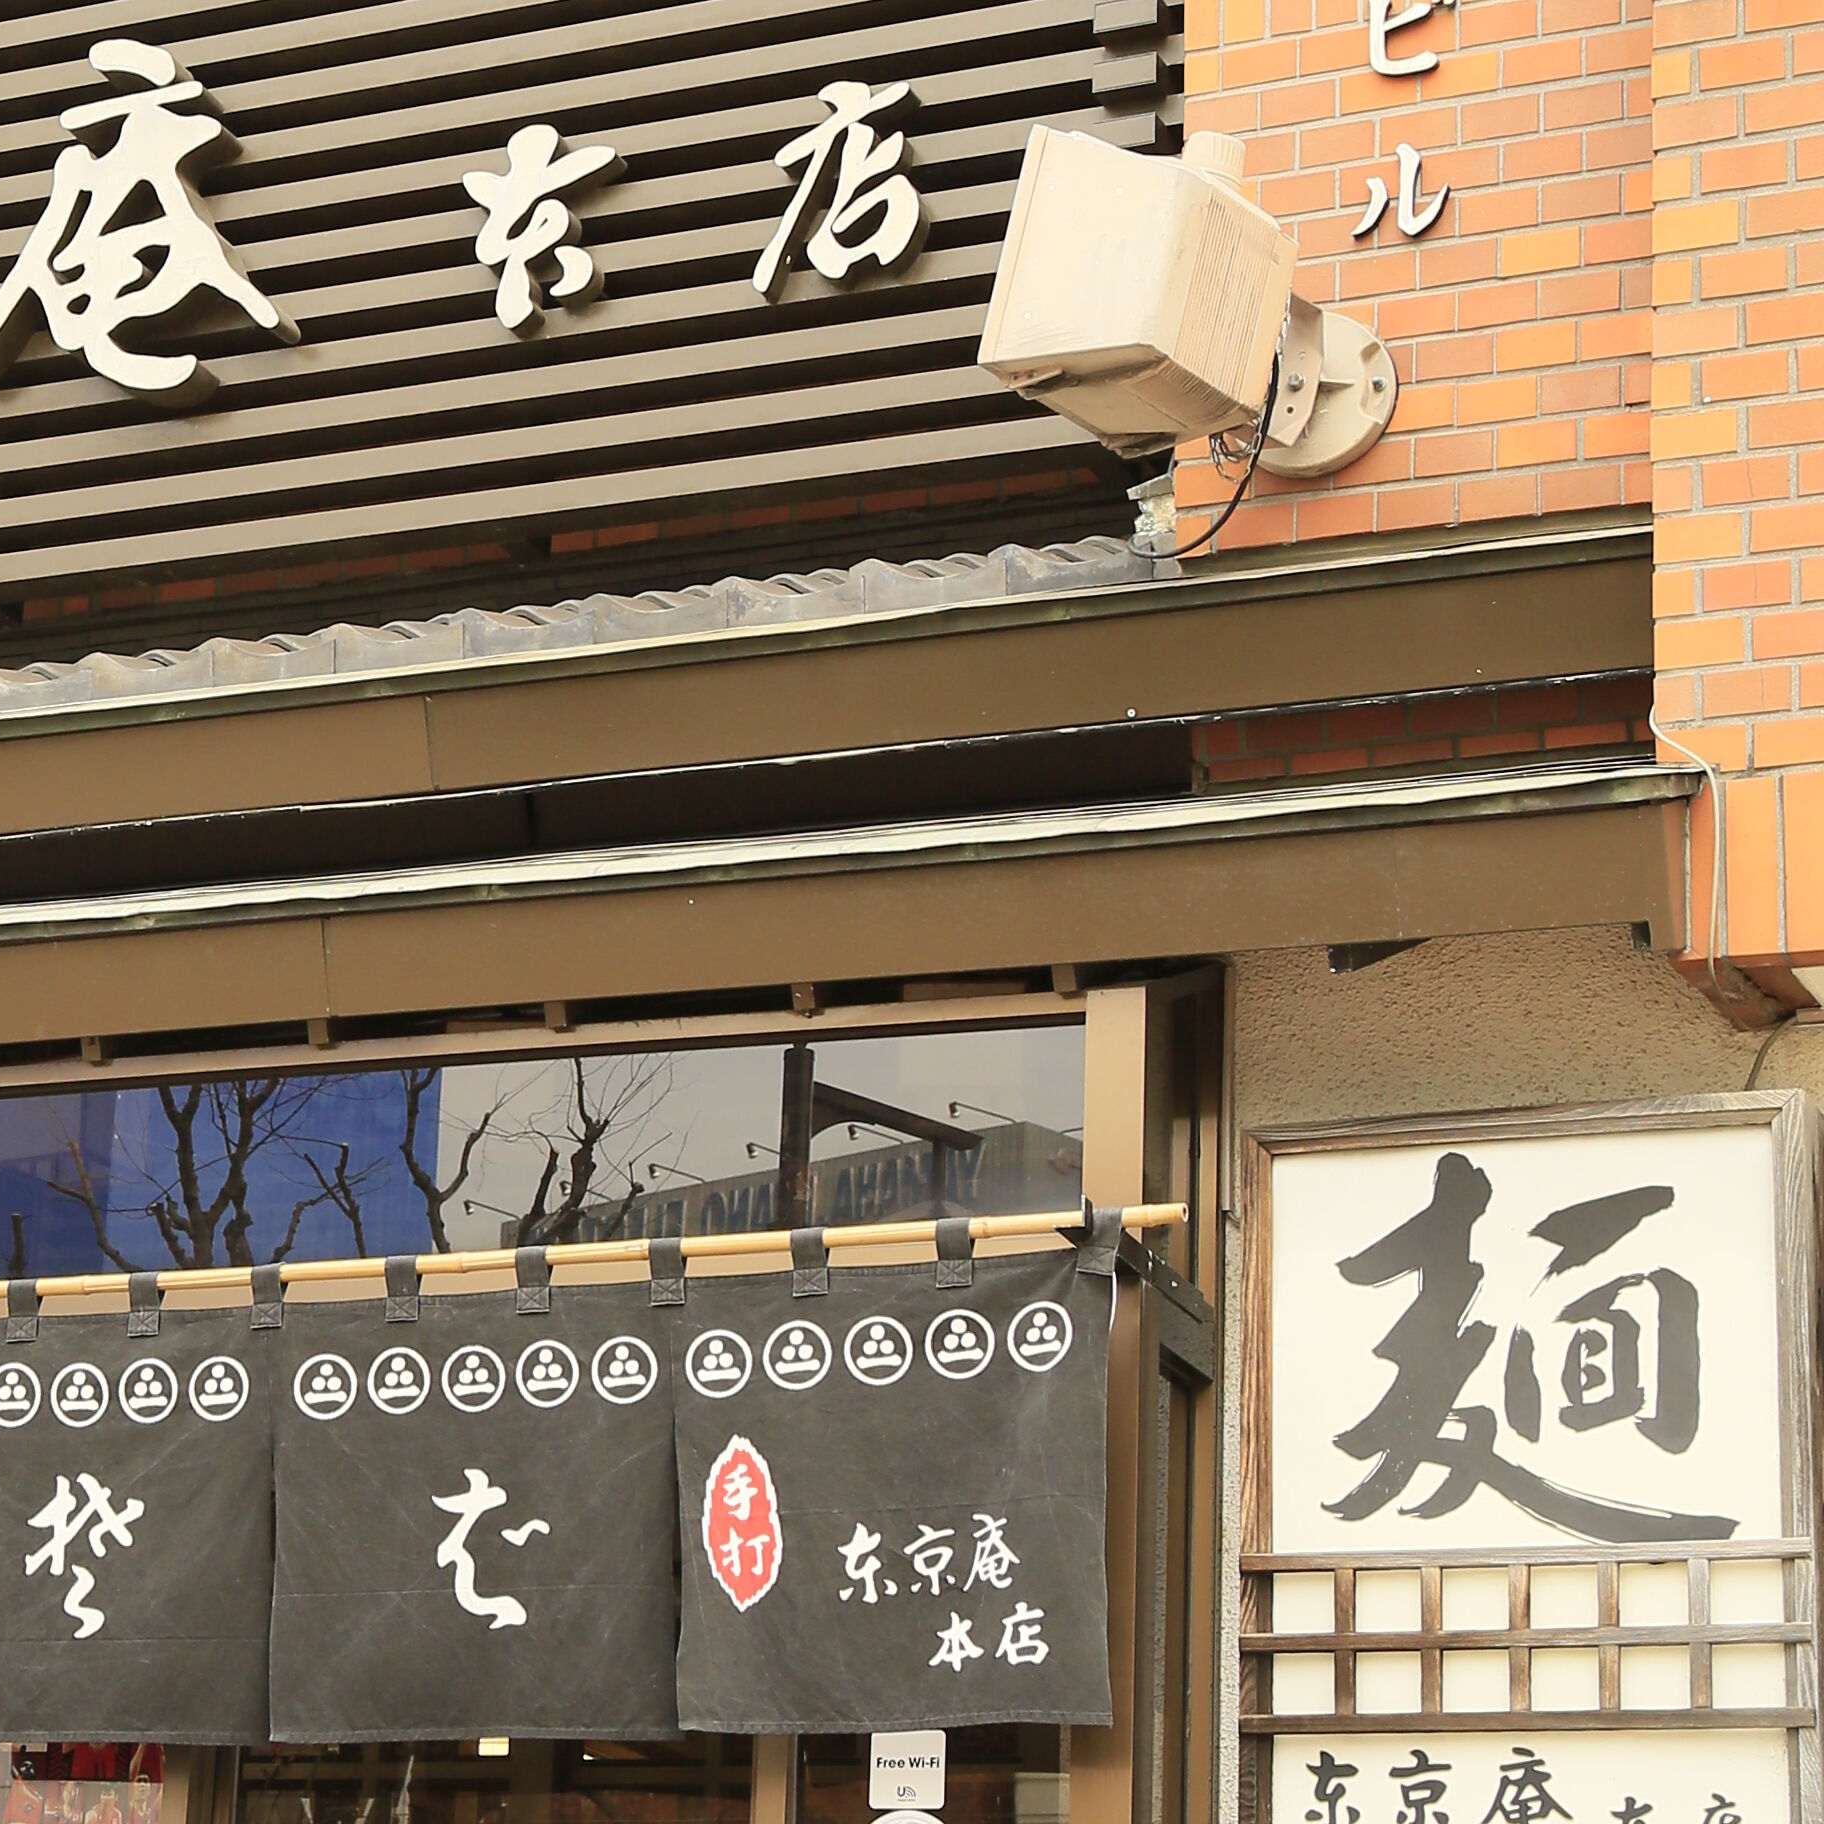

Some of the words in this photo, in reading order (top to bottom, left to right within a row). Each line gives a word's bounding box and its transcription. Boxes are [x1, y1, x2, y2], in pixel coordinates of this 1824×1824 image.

[1321, 1152, 1739, 1544] 麺
[719, 1463, 771, 1577] 手打
[928, 1602, 1050, 1671] 本店
[876, 1757, 905, 1768] Free
[908, 1756, 940, 1768] Wi-Fi
